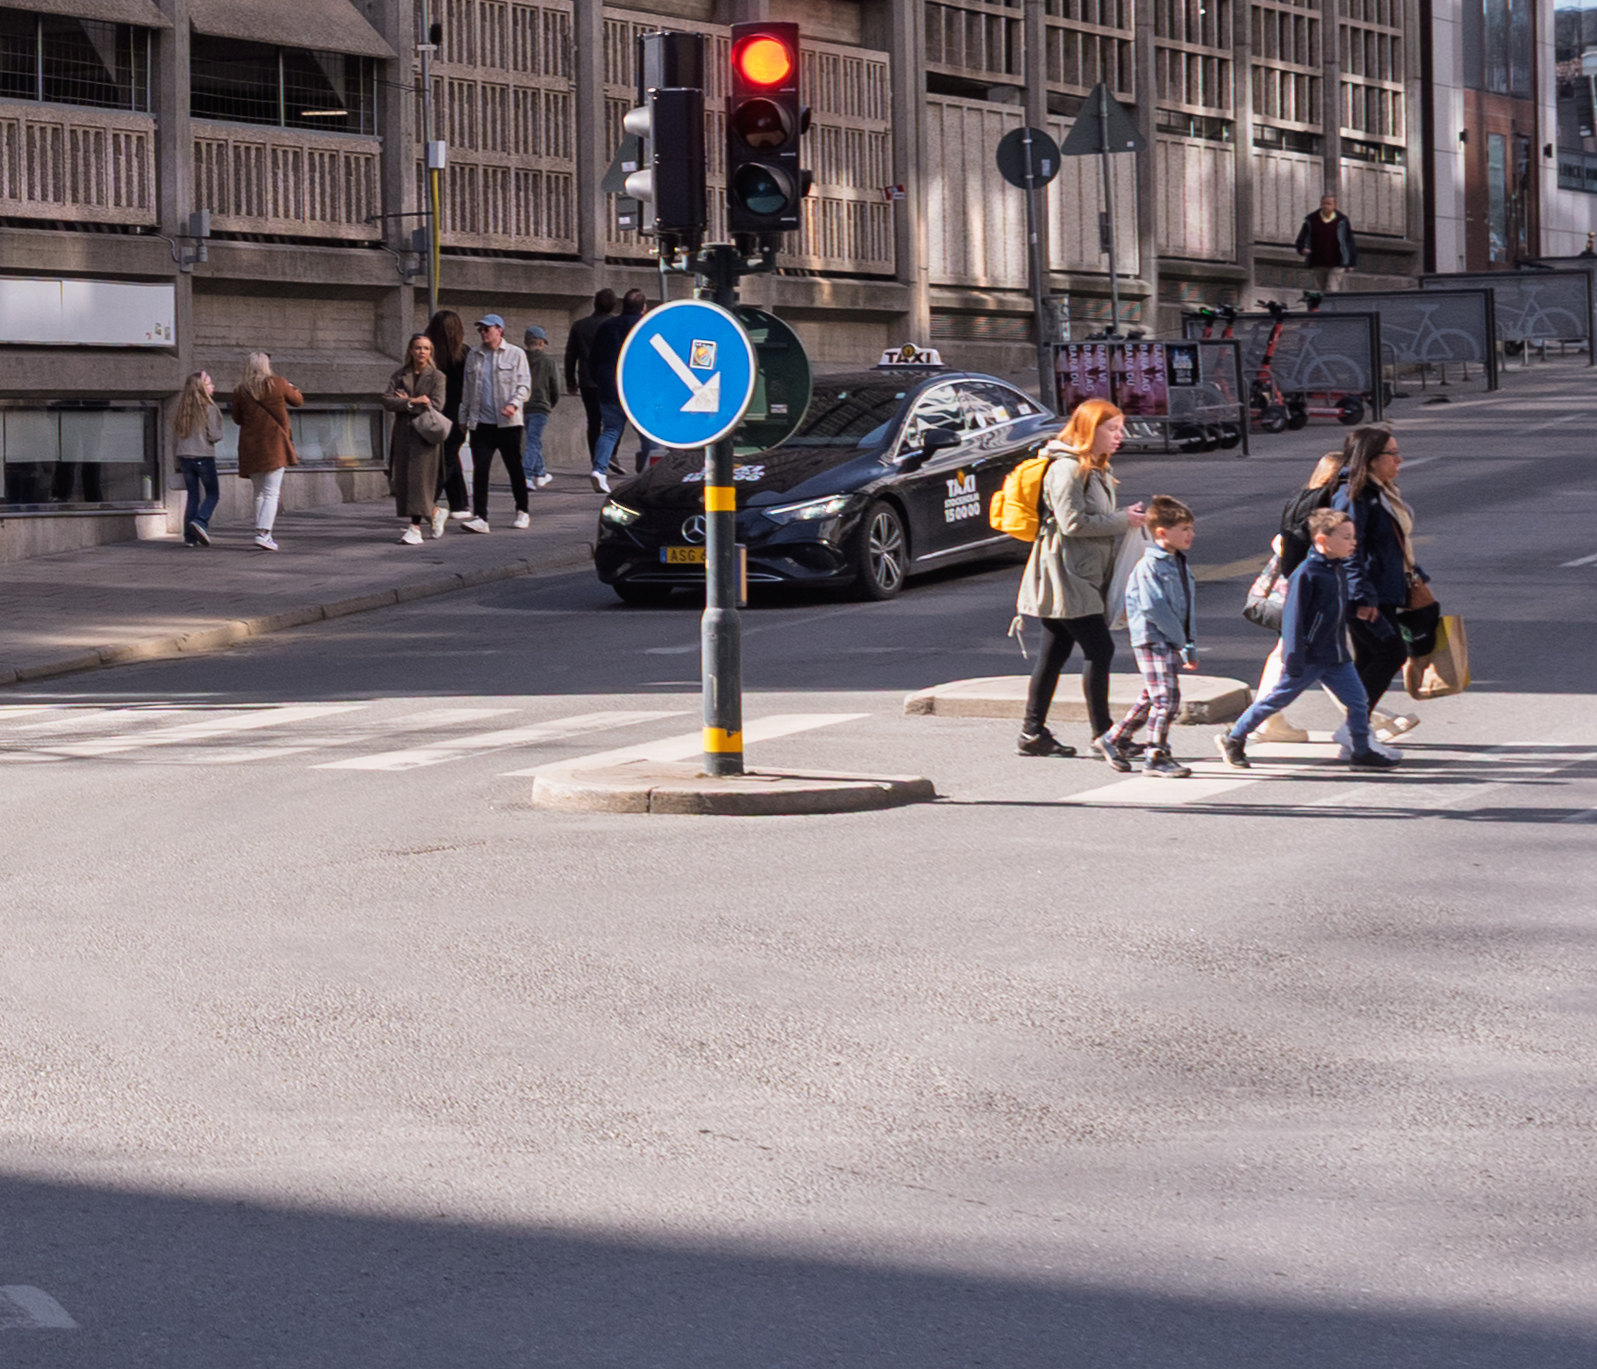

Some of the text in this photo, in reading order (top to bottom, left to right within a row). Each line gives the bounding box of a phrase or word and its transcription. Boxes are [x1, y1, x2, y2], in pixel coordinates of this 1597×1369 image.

[884, 351, 931, 364] TAXI
[1068, 344, 1080, 387] BARA DU
[1083, 344, 1093, 371] BARA
[1124, 343, 1136, 387] BARA DU
[1139, 343, 1150, 371] BARA
[945, 474, 976, 498] TAXI
[669, 549, 695, 562] ASG
